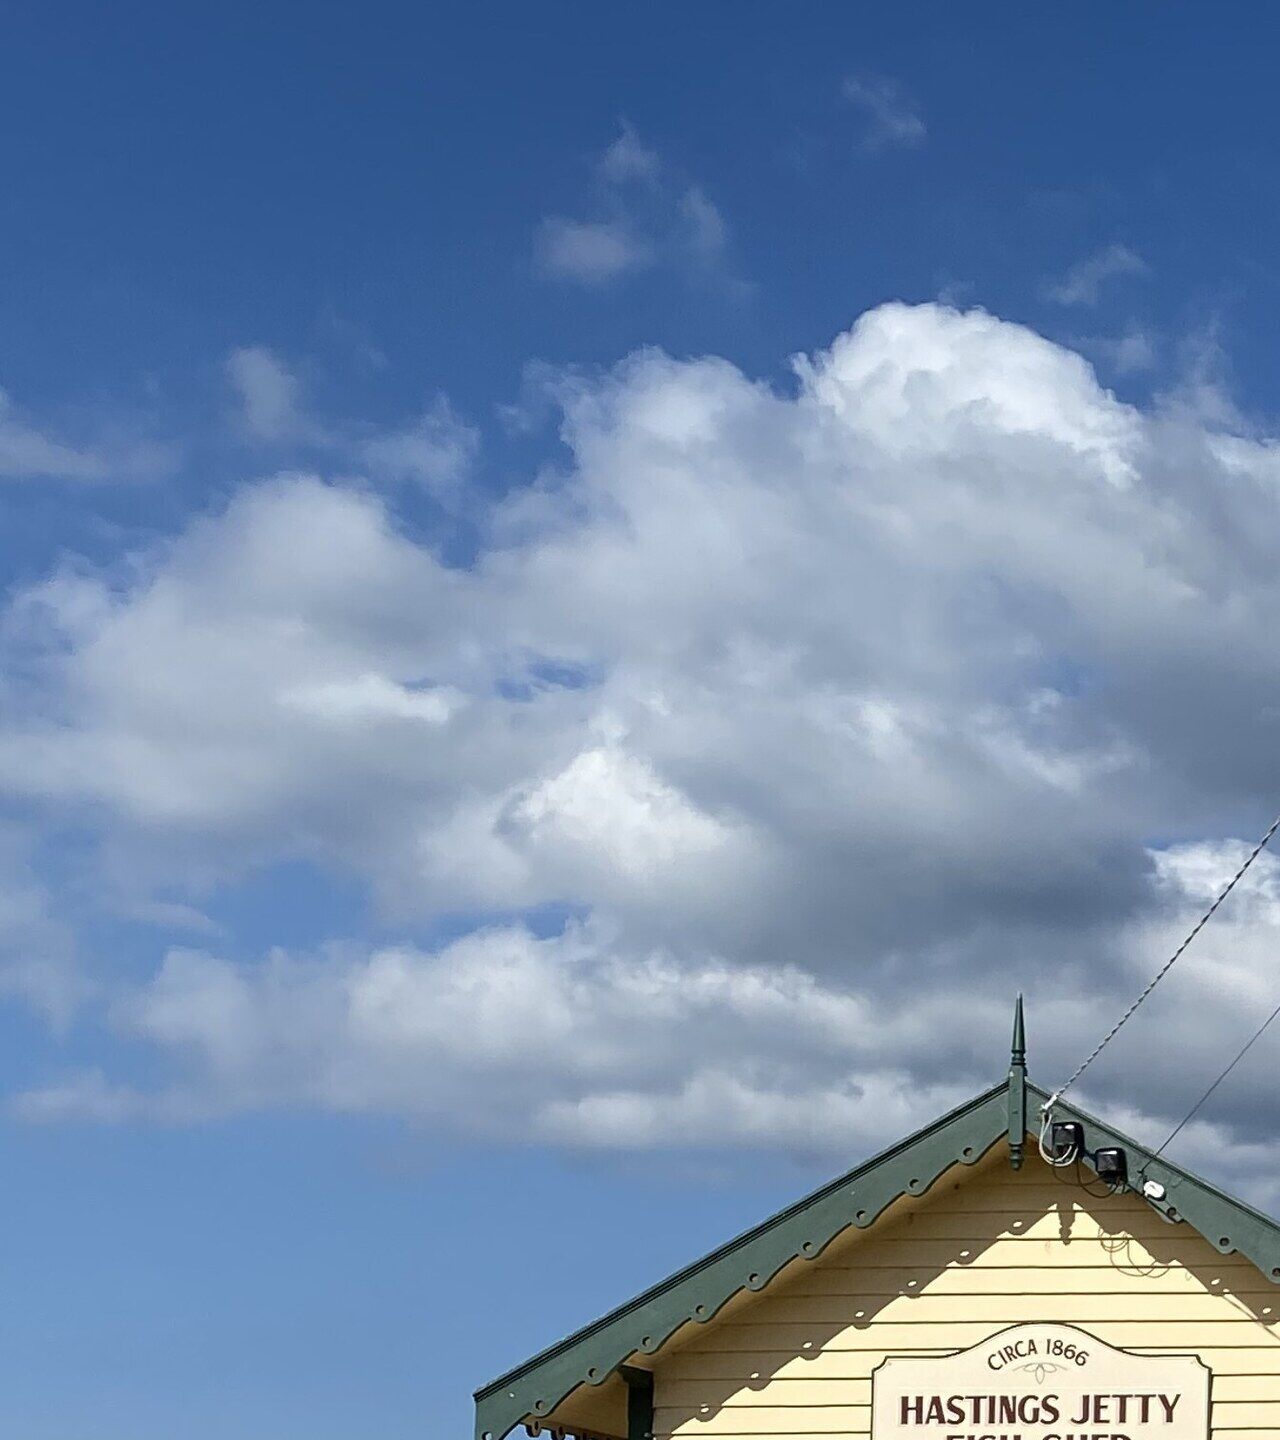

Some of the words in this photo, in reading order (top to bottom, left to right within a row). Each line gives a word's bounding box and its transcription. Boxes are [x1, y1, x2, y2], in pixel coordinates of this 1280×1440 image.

[987, 1339, 1038, 1371] CIRCA
[1046, 1338, 1090, 1367] 1866
[900, 1394, 1060, 1425] HASTINGS
[1070, 1393, 1181, 1425] JETTY
